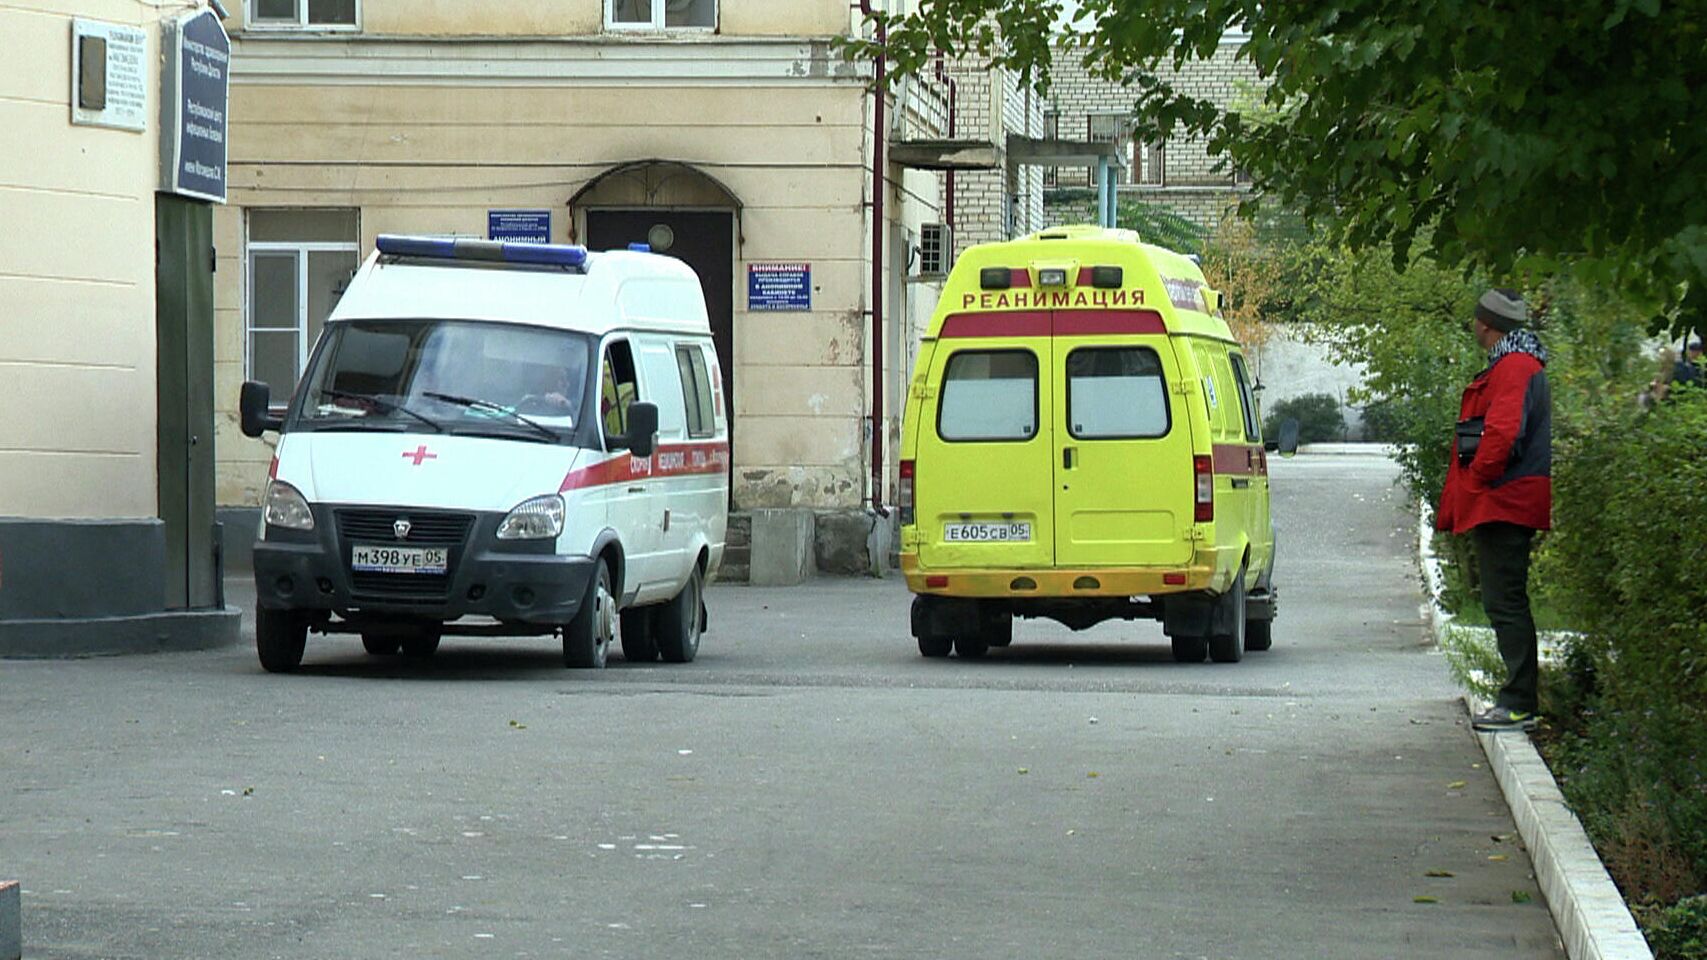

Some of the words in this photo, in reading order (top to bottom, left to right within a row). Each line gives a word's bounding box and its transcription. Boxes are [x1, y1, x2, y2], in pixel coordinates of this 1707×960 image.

[963, 290, 1145, 309] РЕАНИМАЦИЯ
[950, 525, 1008, 540] Е605СВ
[1010, 523, 1025, 536] 05
[357, 549, 422, 567] М398УЕ
[425, 550, 442, 564] 05
